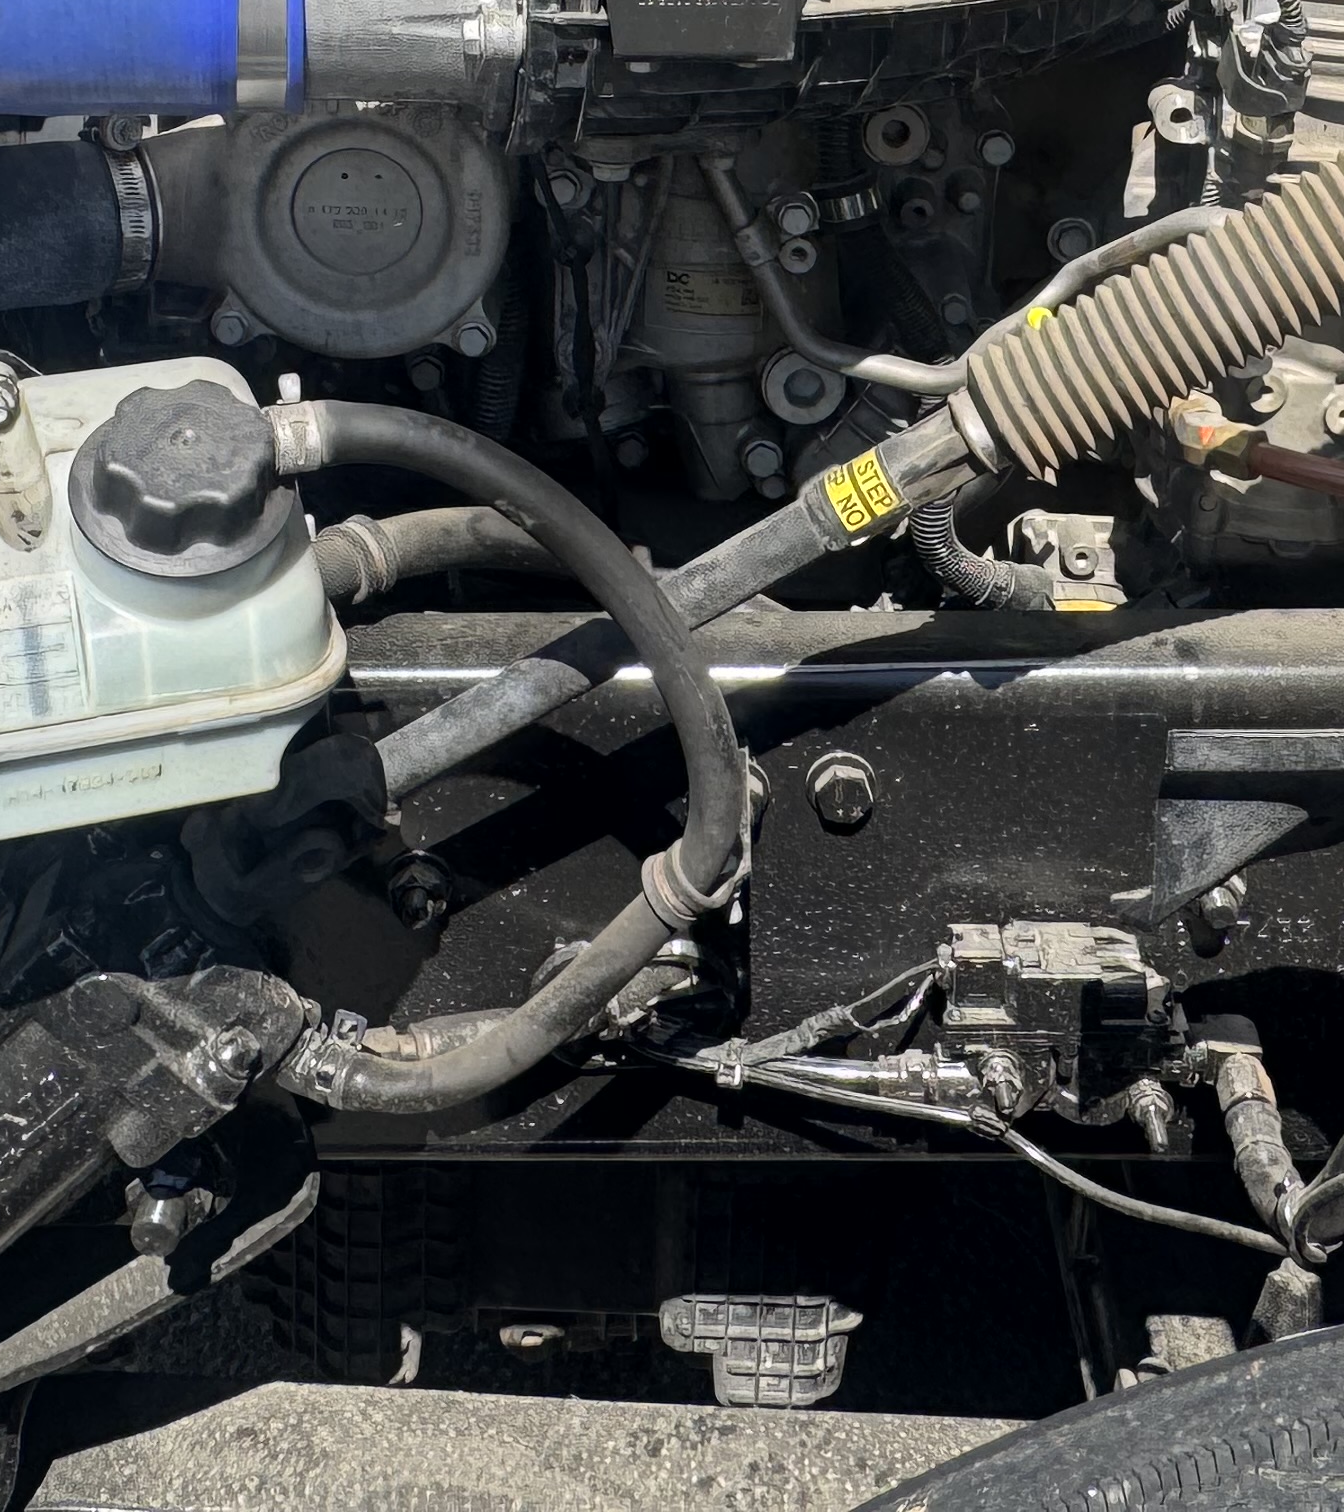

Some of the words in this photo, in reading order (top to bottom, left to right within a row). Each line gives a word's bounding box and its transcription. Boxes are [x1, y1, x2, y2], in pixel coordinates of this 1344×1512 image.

[667, 271, 691, 286] DC
[857, 459, 893, 507] STEP
[836, 493, 865, 526] NO
